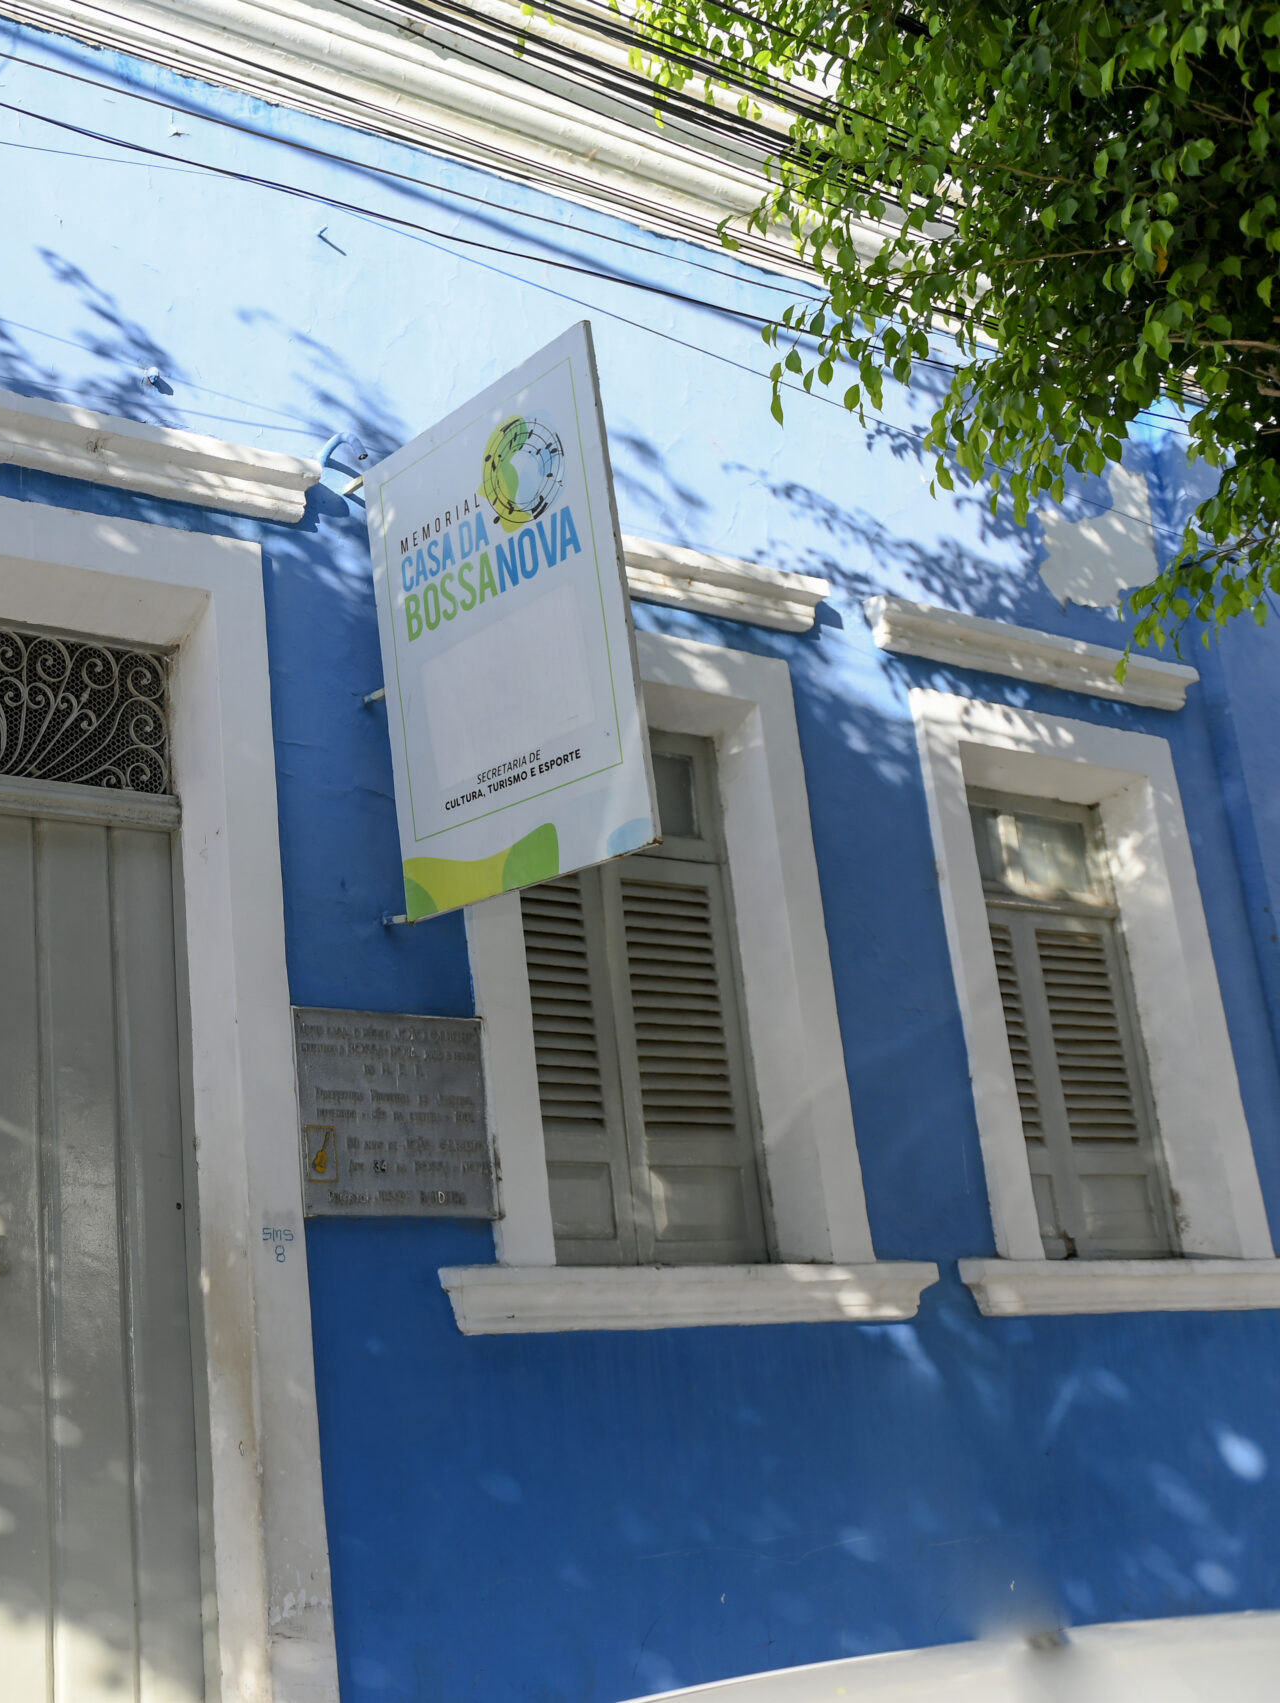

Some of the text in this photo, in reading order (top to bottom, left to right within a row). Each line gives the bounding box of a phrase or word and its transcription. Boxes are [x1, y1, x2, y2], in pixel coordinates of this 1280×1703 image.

[400, 494, 480, 554] MEMORIAL
[401, 513, 489, 592] CASA DA
[445, 749, 581, 810] CULTURA, TURISMO E ESPORTE
[477, 749, 540, 784] SECRETARIA DE
[275, 1245, 286, 1263] 8
